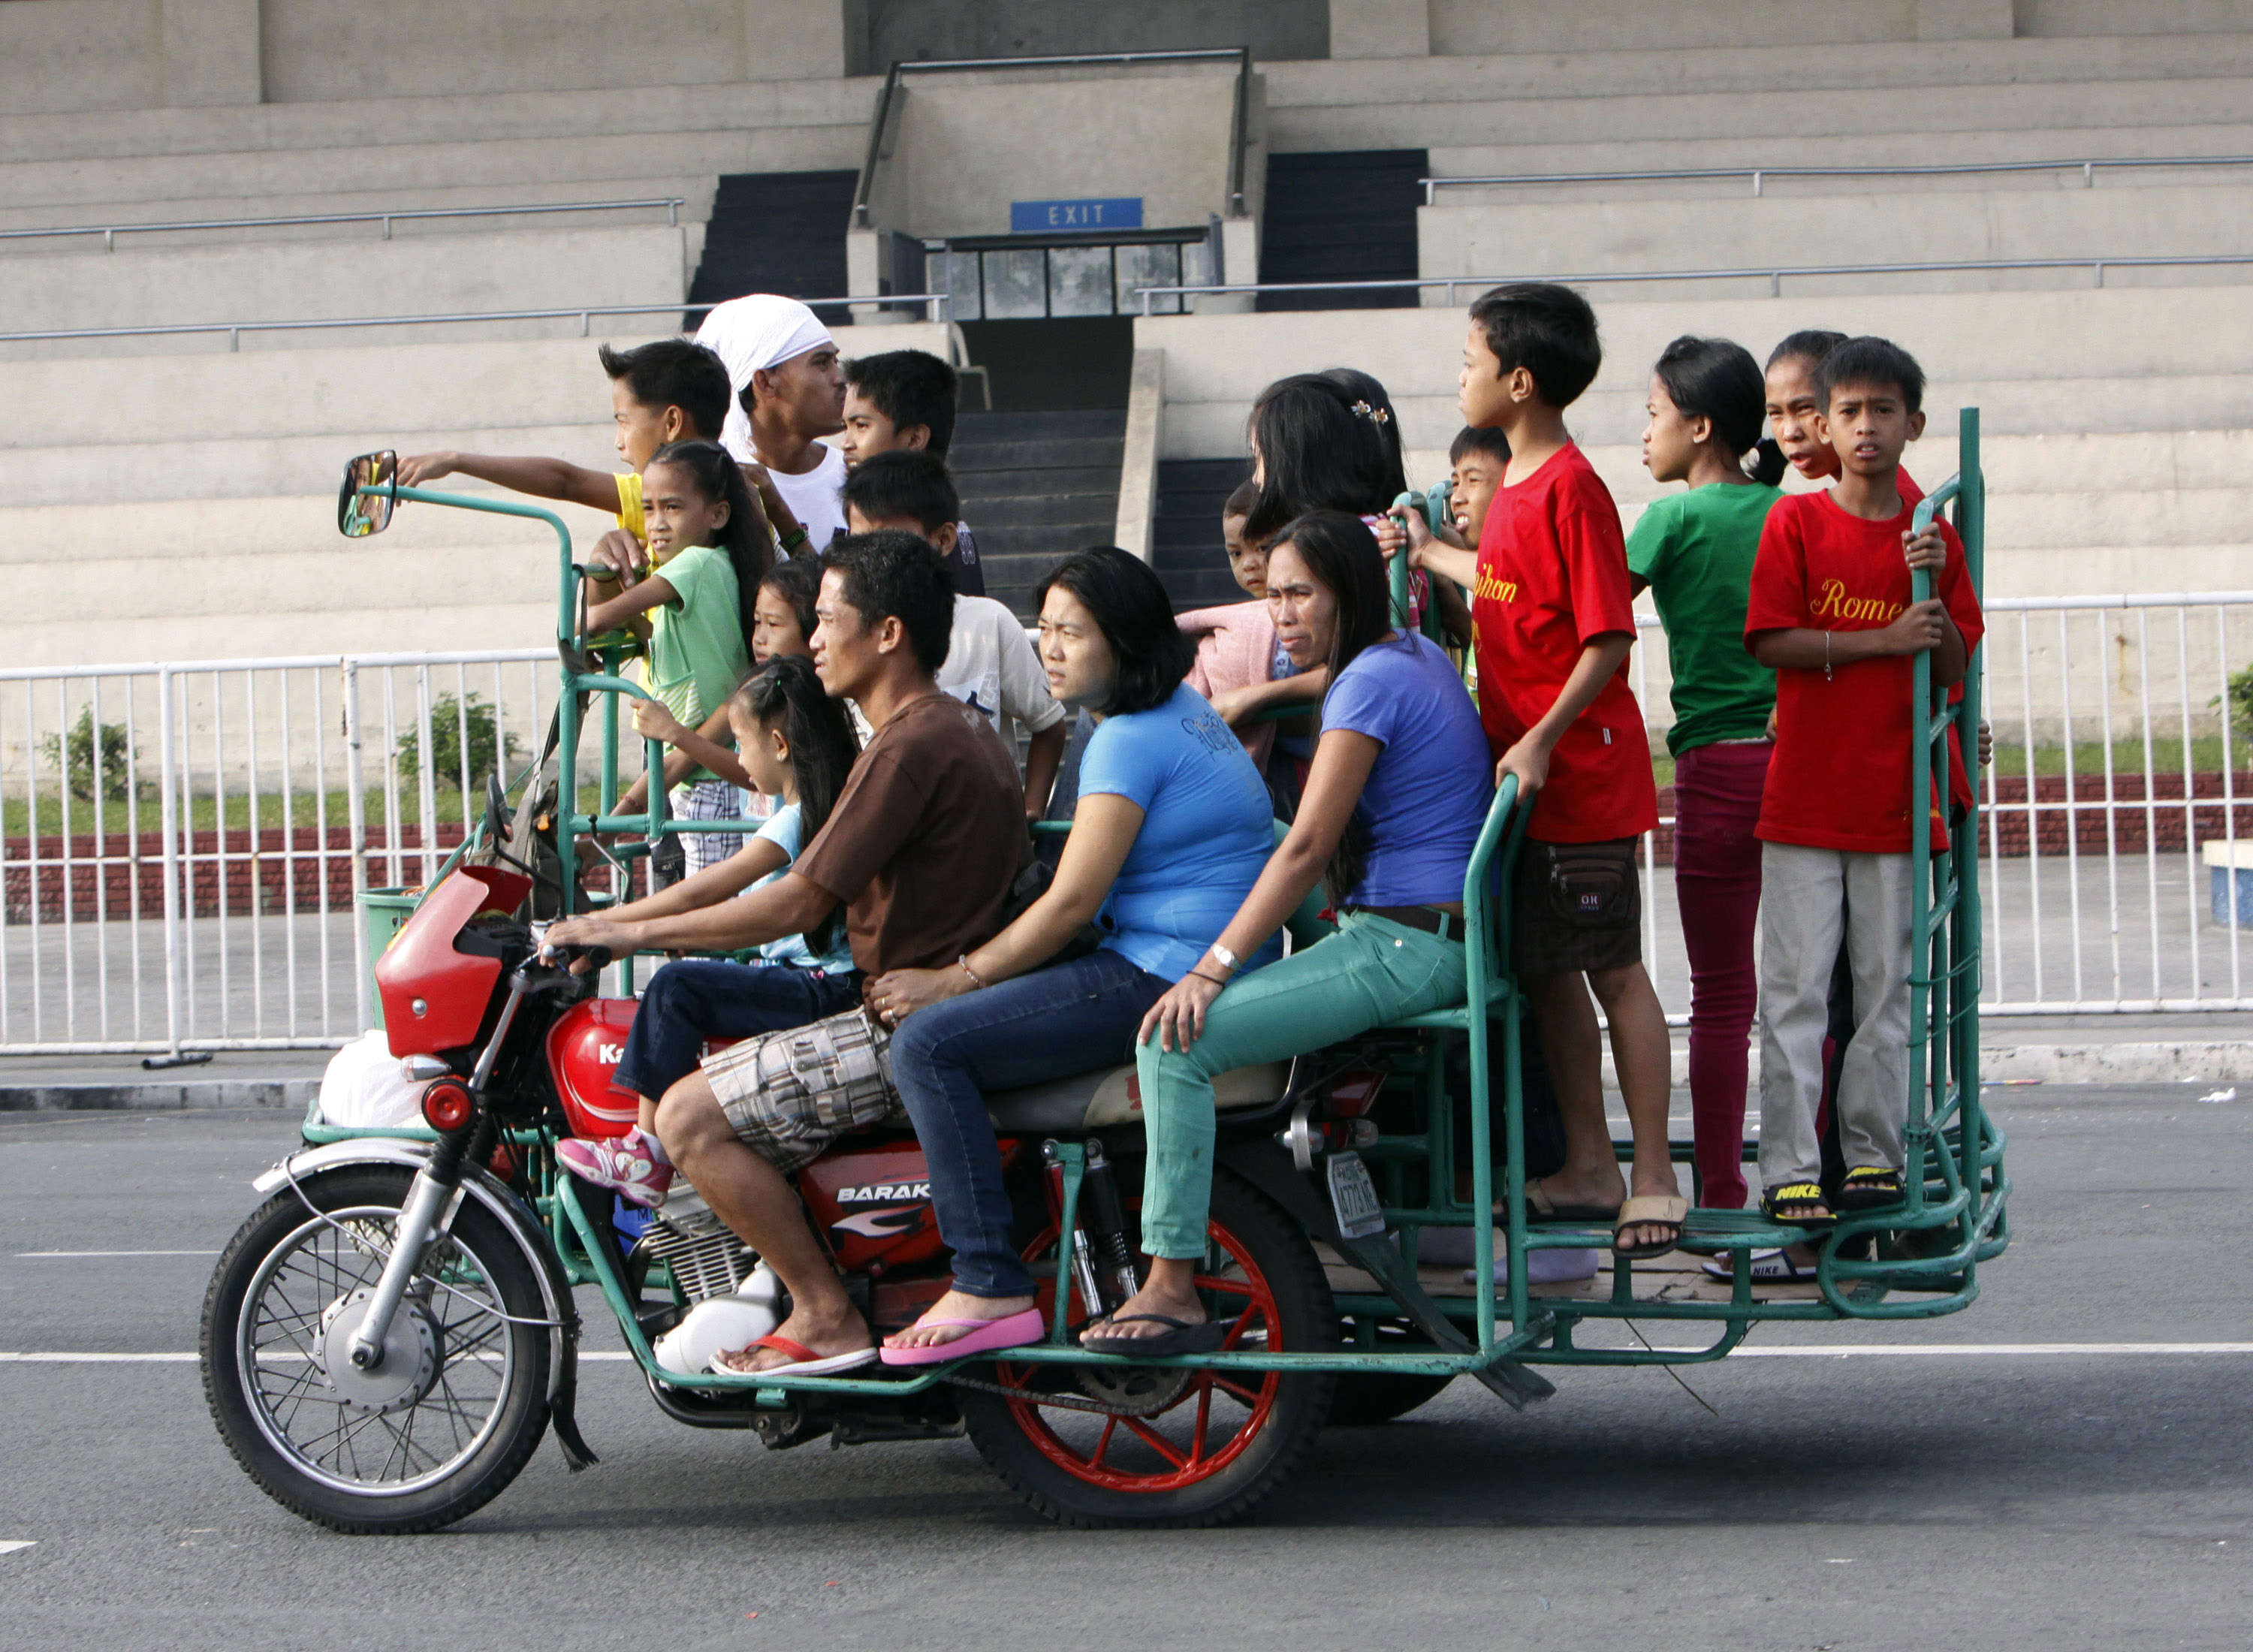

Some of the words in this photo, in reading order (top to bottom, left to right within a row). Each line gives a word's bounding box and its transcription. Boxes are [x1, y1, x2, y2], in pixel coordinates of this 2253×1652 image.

[1048, 204, 1103, 225] EXIT
[1775, 1183, 1822, 1201] NIKE
[1754, 1265, 1778, 1275] NIKE
